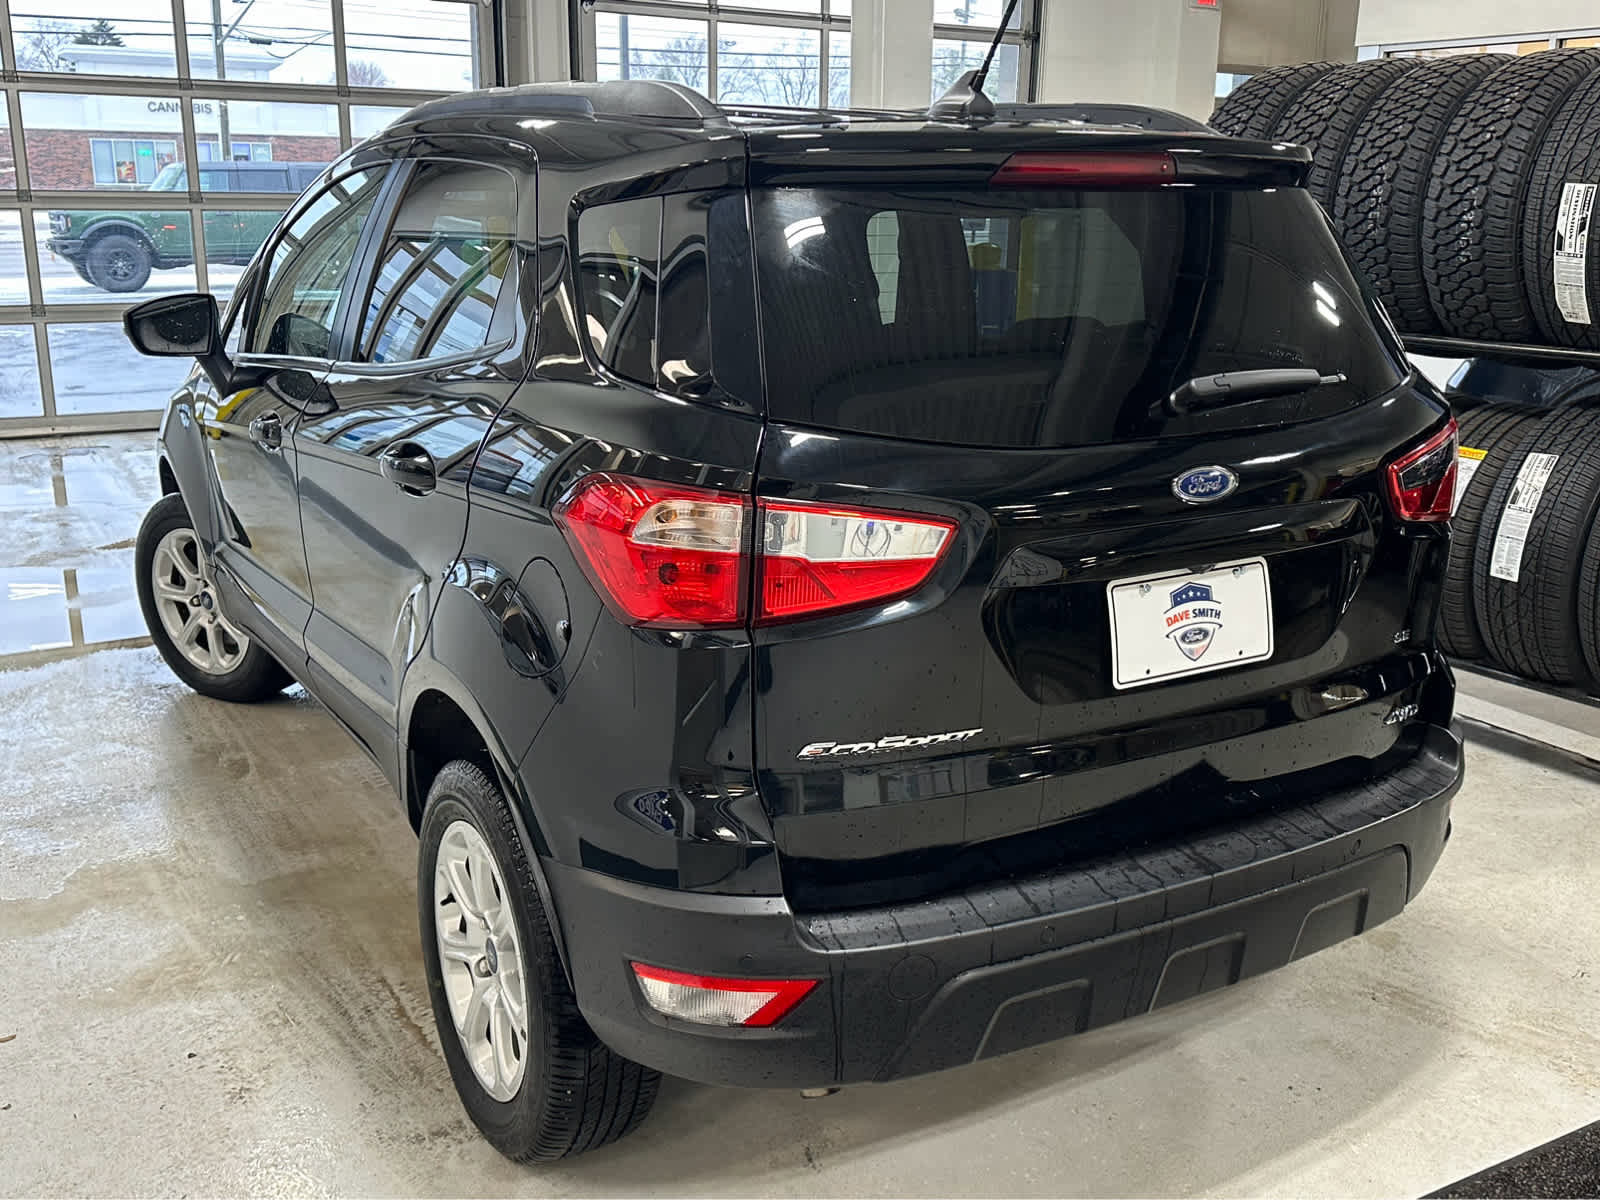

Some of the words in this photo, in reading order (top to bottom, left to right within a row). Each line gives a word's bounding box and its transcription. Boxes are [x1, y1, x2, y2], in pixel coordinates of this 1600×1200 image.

[147, 101, 213, 114] CANNBIS
[1166, 609, 1191, 627] DAVE
[1192, 608, 1221, 619] SMITH
